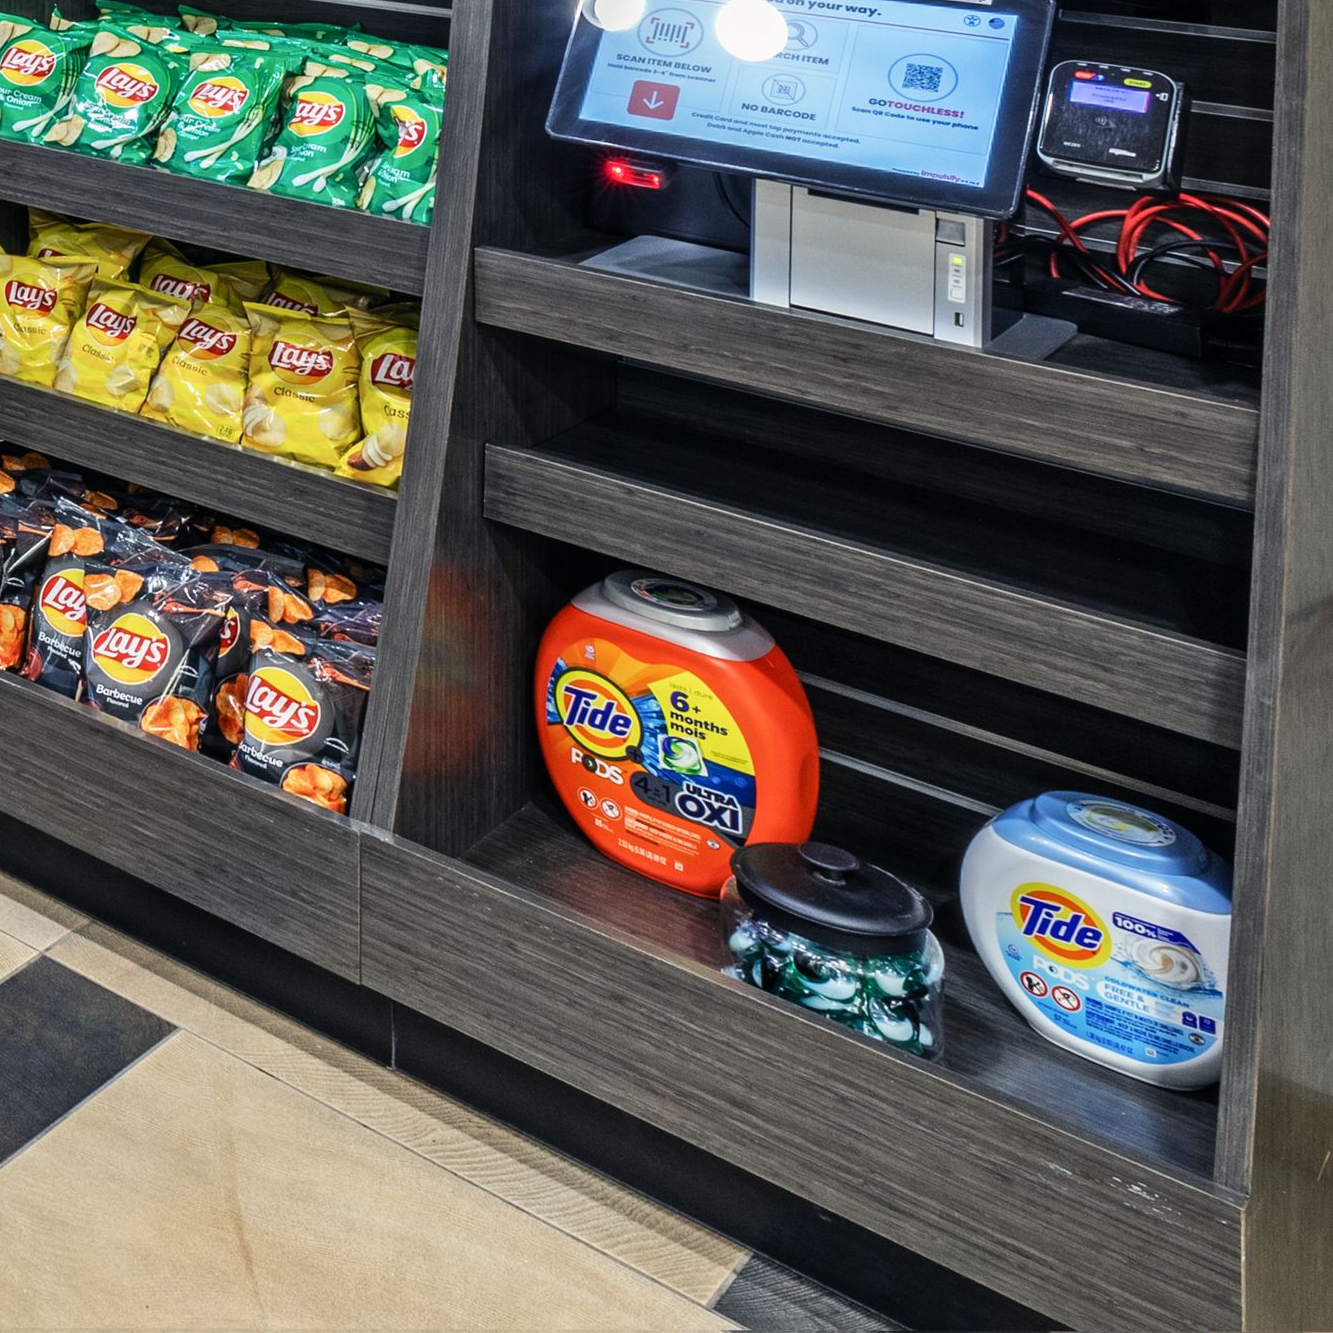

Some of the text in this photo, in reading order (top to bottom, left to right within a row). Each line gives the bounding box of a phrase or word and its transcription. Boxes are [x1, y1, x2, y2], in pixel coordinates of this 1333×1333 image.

[806, 0, 844, 13] your
[845, 5, 882, 17] way.
[1, 47, 56, 78] Lay's
[616, 53, 712, 74] SCAN ITEM BELOW
[801, 55, 829, 66] ITEM
[14, 90, 42, 103] Cream
[99, 67, 158, 101] Lay's
[741, 102, 817, 122] NO BARCODE
[852, 106, 979, 131] Scan Code phone
[6, 280, 57, 312] Lay's
[13, 322, 47, 337] Classic
[86, 304, 136, 339] Lay's
[179, 318, 237, 355] Lay's
[81, 343, 115, 364] Classic
[171, 354, 208, 377] Classic
[270, 342, 334, 376] Lay's
[272, 385, 317, 404] Classic
[37, 630, 83, 659] Barbecue
[93, 626, 169, 669] Lay's
[95, 682, 144, 707] Barbecue
[246, 675, 321, 731] Lay's
[563, 685, 632, 738] Tide
[670, 710, 728, 736] months
[670, 722, 706, 741] mois
[570, 747, 624, 785] PODS
[685, 782, 738, 810] ULTRA
[677, 793, 742, 833] OXI
[1019, 895, 1103, 950] Tide
[1114, 915, 1158, 940] 100%
[1104, 975, 1158, 999] COLDWATER
[1104, 991, 1150, 1013] GENTLE
